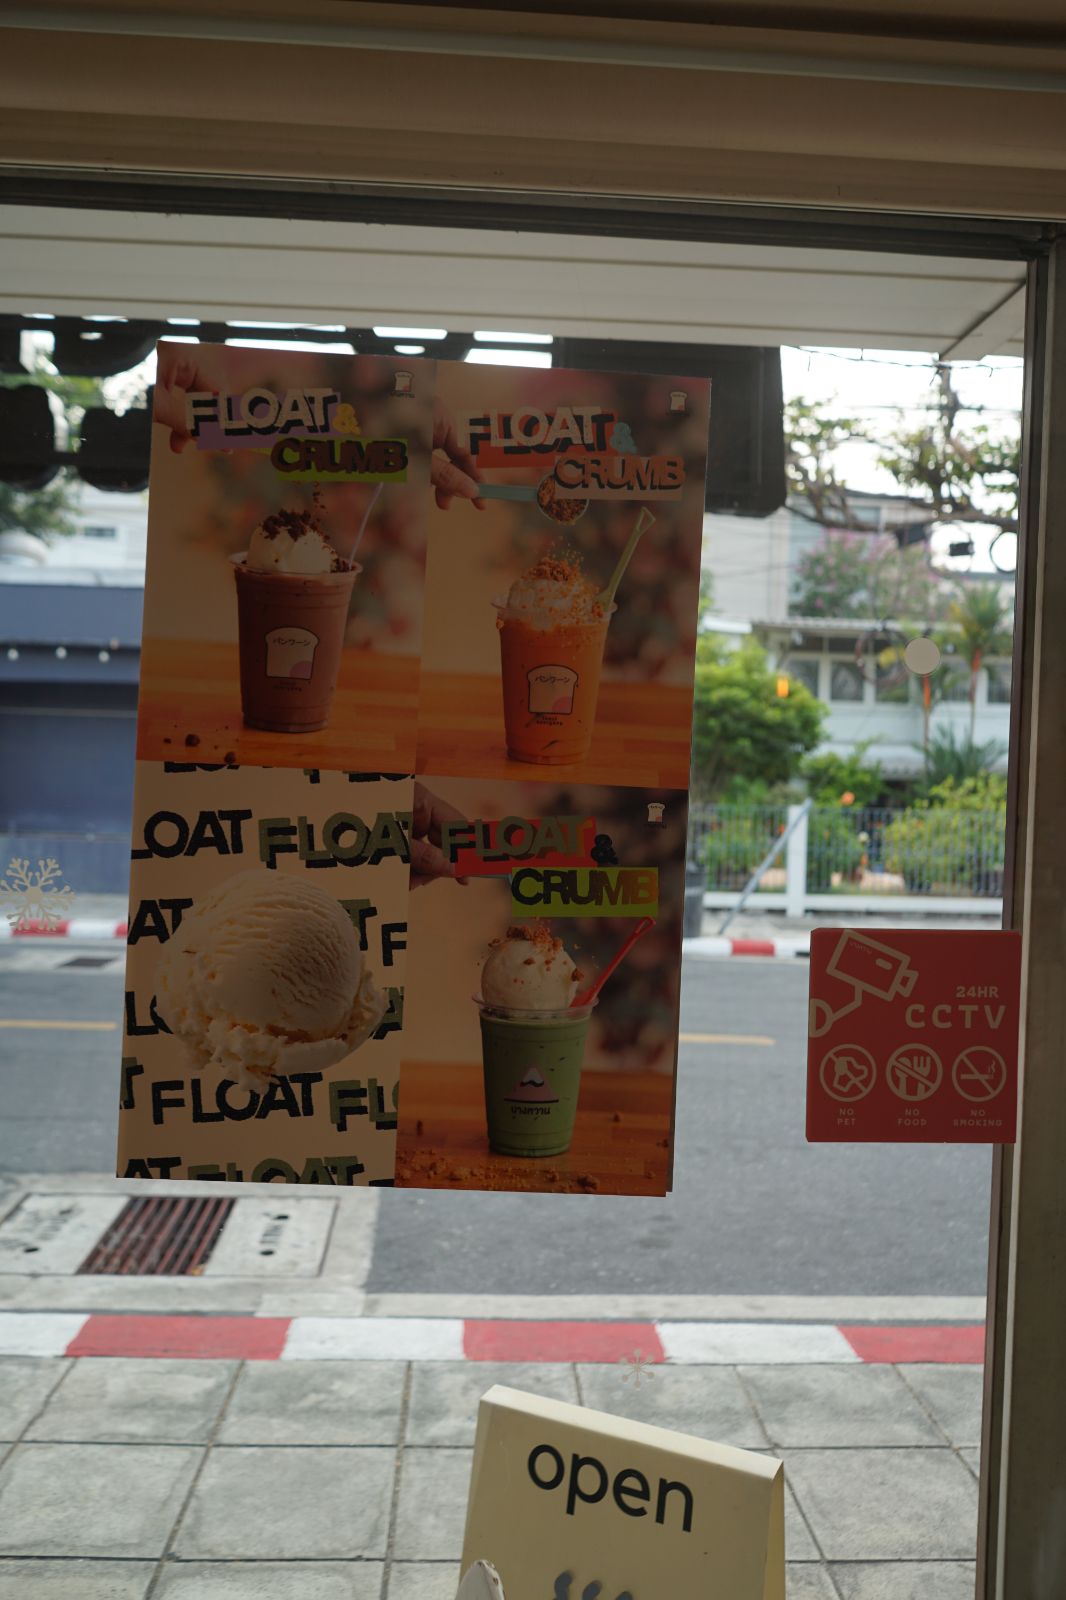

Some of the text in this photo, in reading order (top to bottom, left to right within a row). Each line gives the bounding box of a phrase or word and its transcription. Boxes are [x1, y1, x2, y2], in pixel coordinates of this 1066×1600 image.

[185, 388, 363, 436] FLOAT &
[456, 406, 637, 455] FLOAT &
[270, 437, 408, 474] CRUMB
[553, 455, 686, 490] CRUMB
[441, 815, 619, 865] FLOAT &
[511, 868, 658, 905] CRUMB
[956, 986, 999, 999] 24HR
[905, 1003, 1007, 1029] CCTV
[837, 1118, 857, 1127] PET
[839, 1108, 855, 1117] NO
[897, 1118, 928, 1128] FOOD
[905, 1108, 921, 1117] NO
[953, 1118, 1003, 1128] SMOKING
[969, 1109, 987, 1118] NO
[527, 1443, 694, 1533] open
